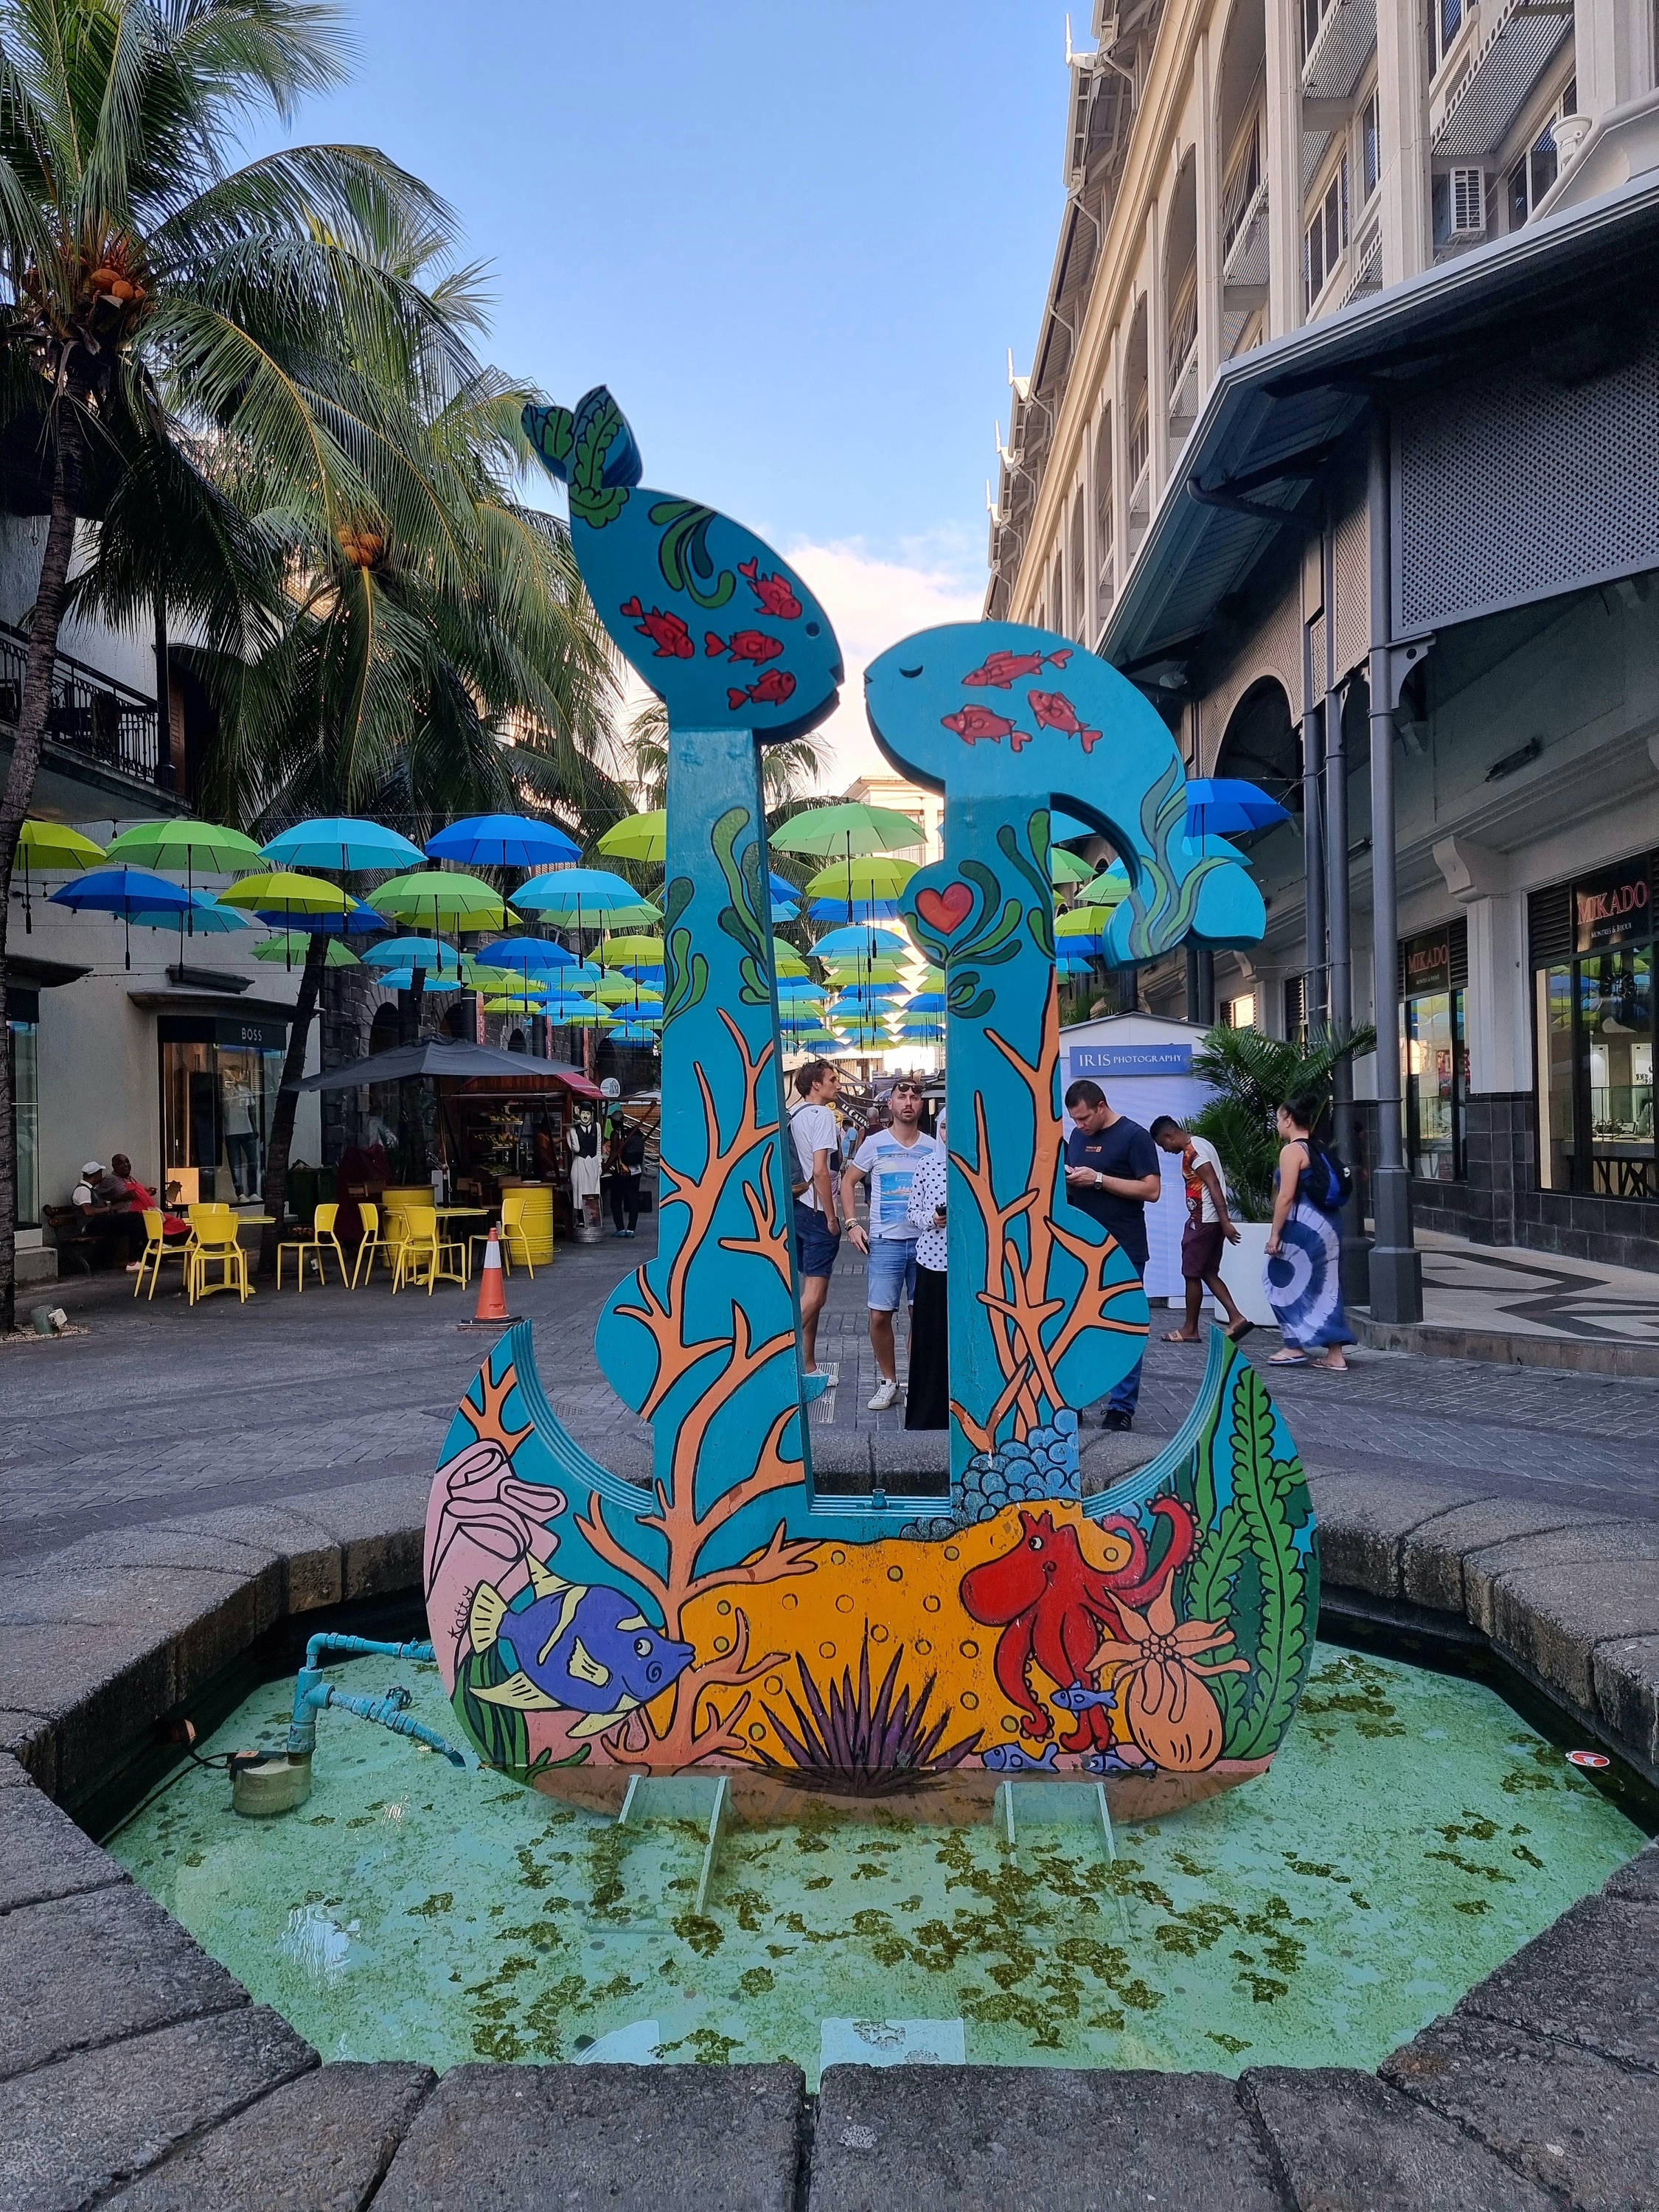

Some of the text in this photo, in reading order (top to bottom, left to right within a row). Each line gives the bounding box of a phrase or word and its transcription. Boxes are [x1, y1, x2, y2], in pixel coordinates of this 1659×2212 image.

[1576, 880, 1647, 925] MIKADO
[1408, 944, 1448, 974] MIKADO
[241, 1027, 262, 1042] BOSS
[1079, 1054, 1182, 1067] IRIS PHOTOGRAPHY
[841, 1103, 870, 1129] LE CASIN
[447, 1585, 474, 1640] Katty
